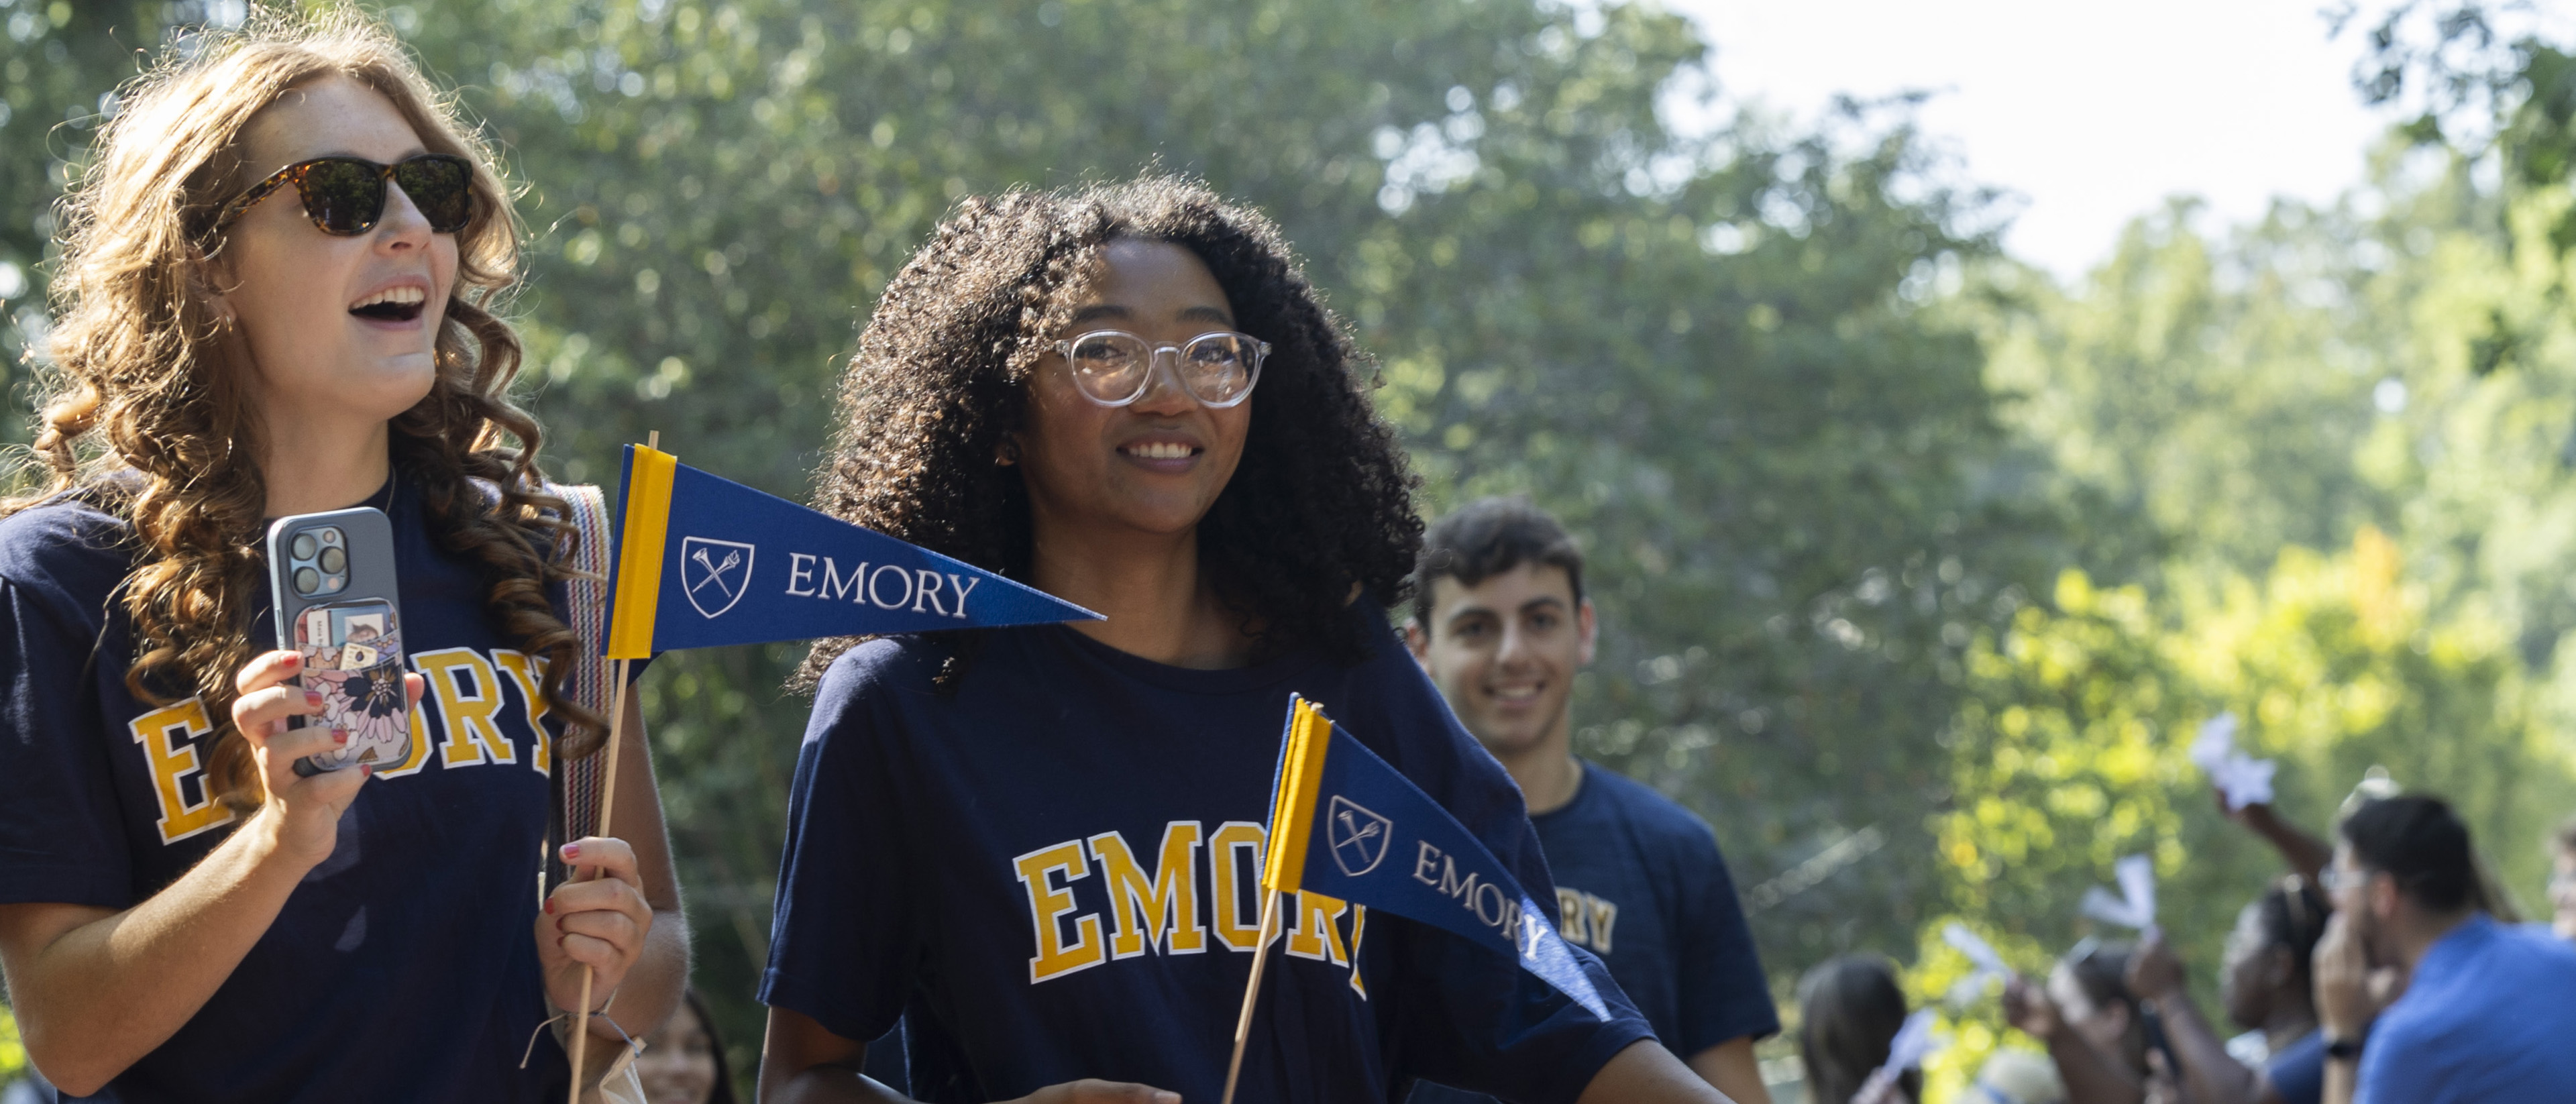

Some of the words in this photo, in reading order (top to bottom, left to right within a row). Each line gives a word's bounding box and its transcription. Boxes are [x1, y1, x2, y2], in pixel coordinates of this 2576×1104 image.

[786, 552, 980, 618] EMORY
[129, 647, 551, 845] ERY
[1411, 840, 1548, 960] EMORY
